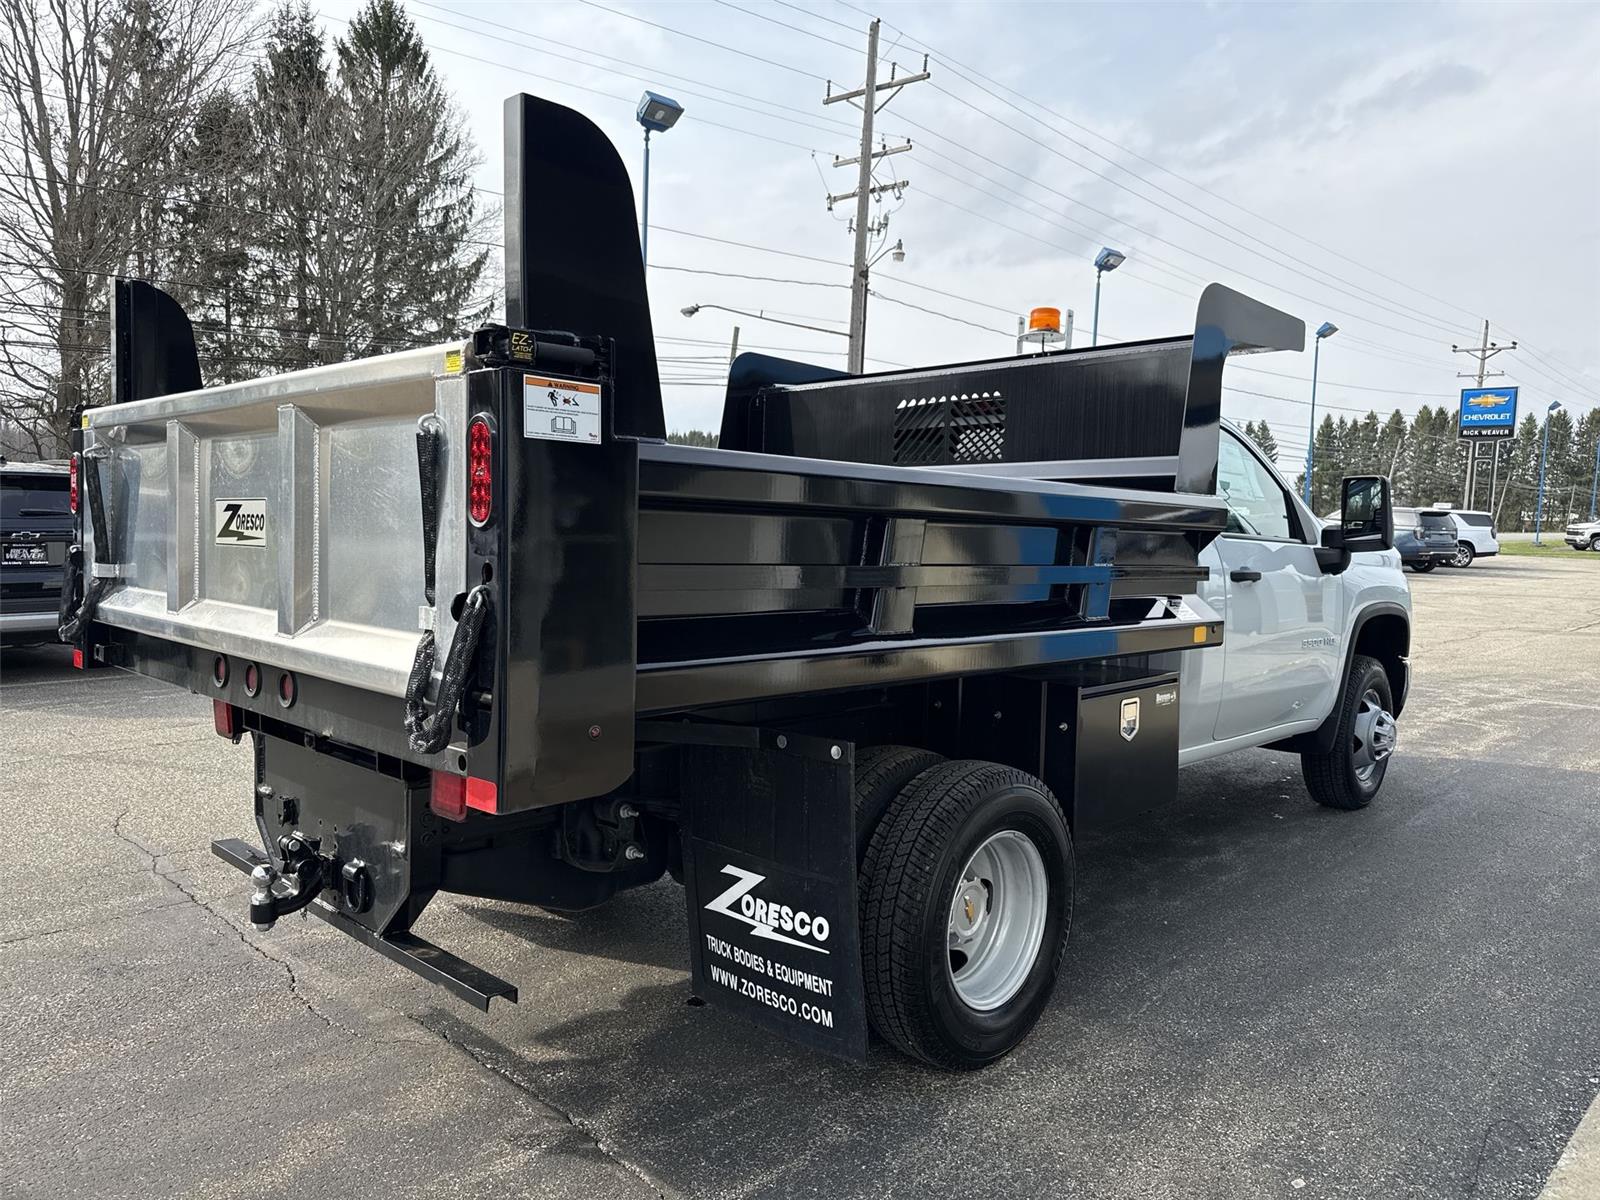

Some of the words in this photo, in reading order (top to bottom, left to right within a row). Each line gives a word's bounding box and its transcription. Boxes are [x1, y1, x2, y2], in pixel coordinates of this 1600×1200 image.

[554, 382, 579, 391] WARNING
[217, 504, 265, 541] ZORESCO
[704, 864, 830, 954] ZORESCO
[706, 934, 733, 961] TRUCK
[733, 946, 765, 974] BODIES
[767, 960, 774, 978] &
[775, 963, 833, 997] EQUIPMENT
[710, 965, 834, 1029] WWW.ZORESCO.COM
